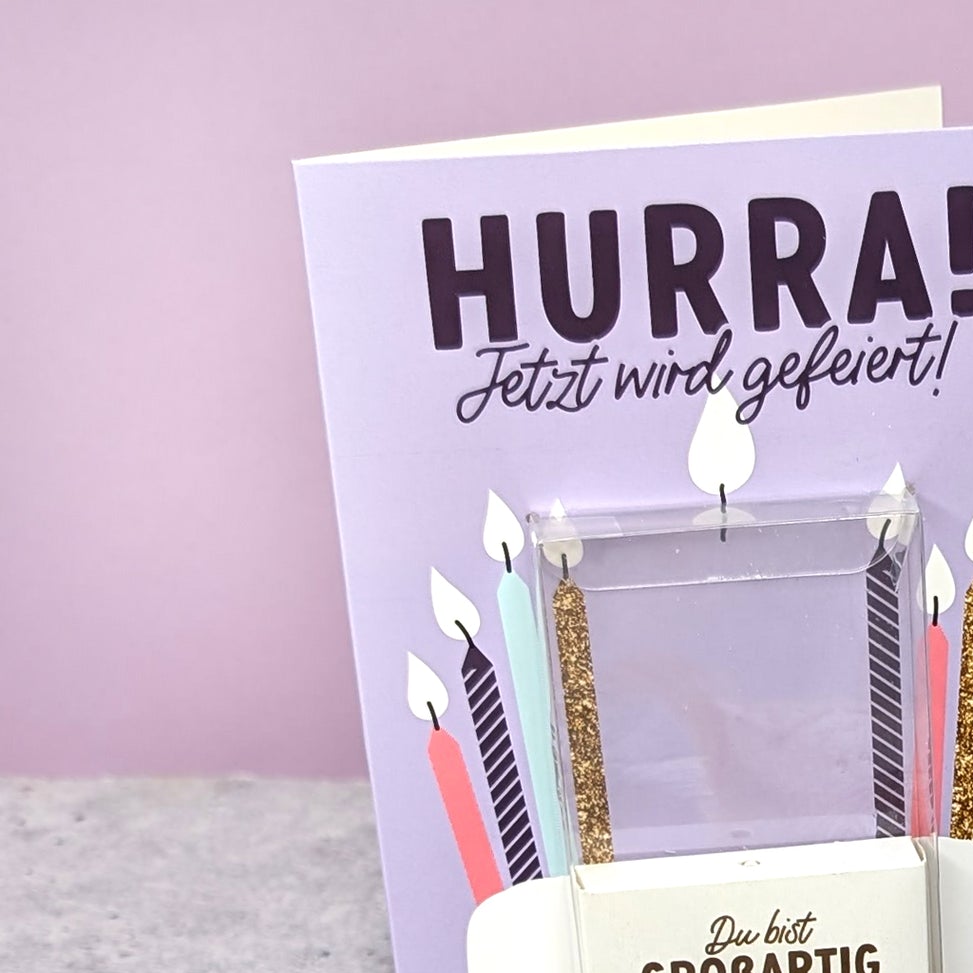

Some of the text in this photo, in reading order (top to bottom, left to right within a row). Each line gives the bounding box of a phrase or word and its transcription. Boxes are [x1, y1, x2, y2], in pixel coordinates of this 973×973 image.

[456, 321, 958, 424] Jetzt wird gefeiert!
[705, 908, 817, 955] Du bist
